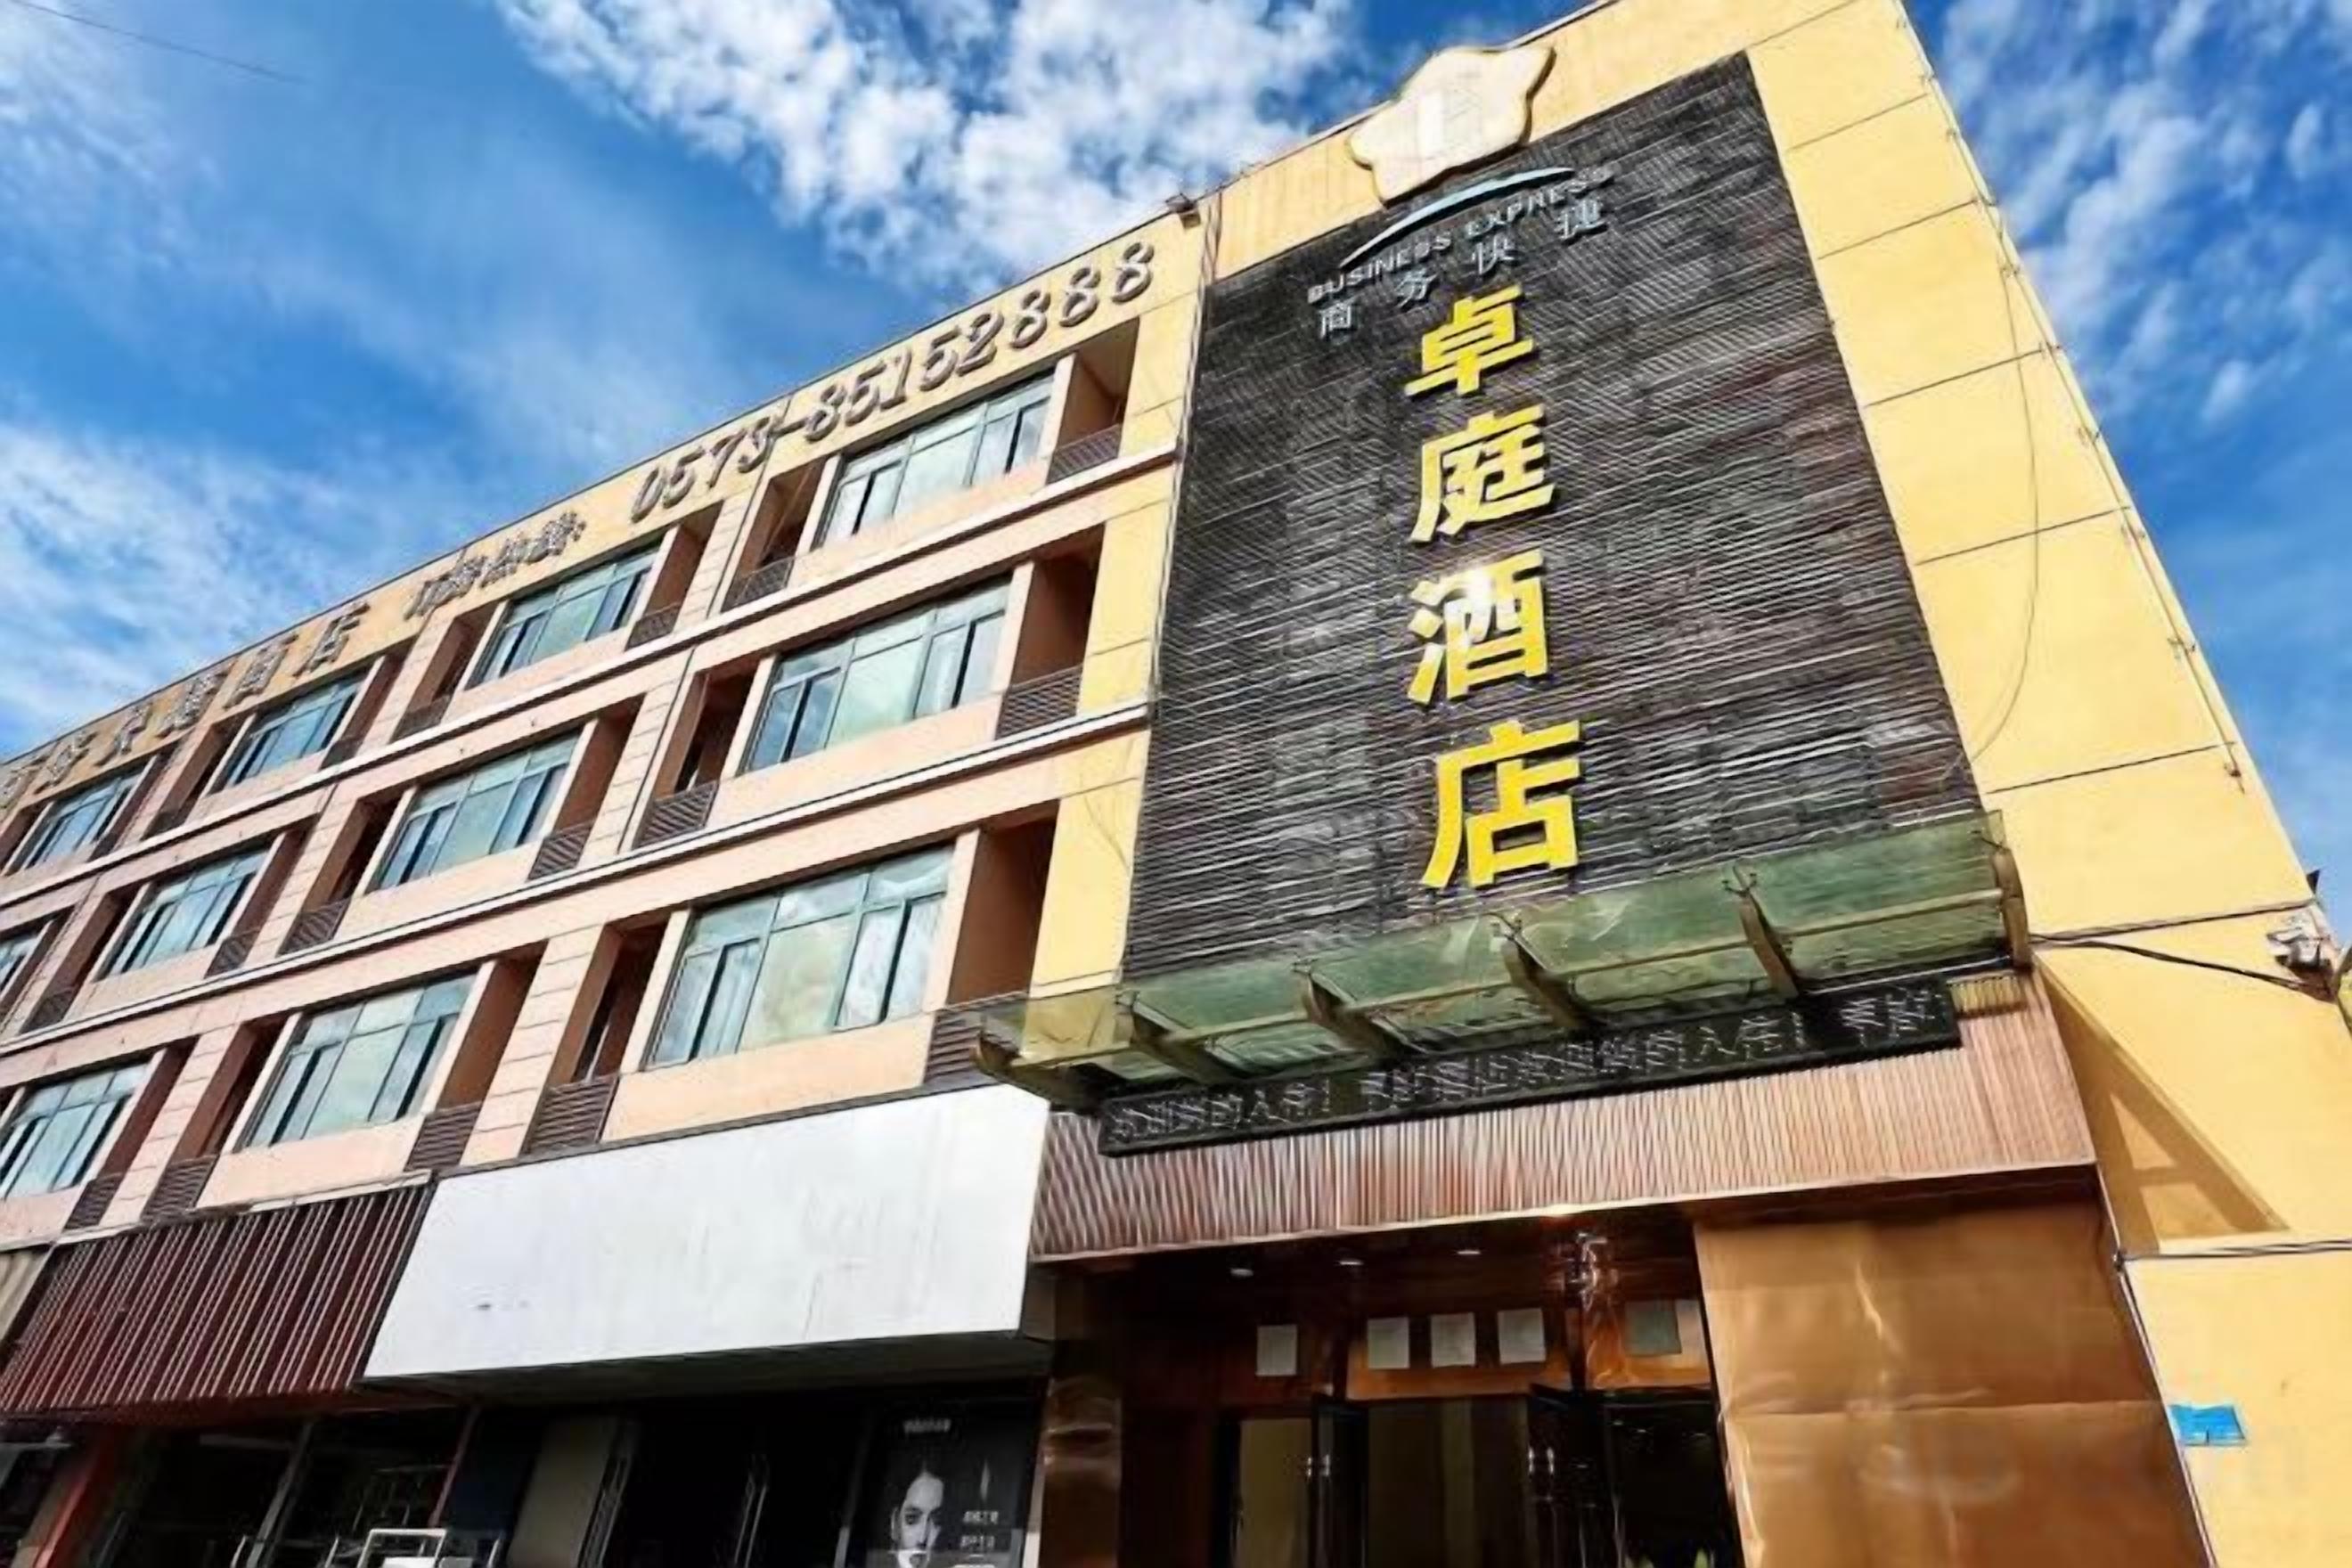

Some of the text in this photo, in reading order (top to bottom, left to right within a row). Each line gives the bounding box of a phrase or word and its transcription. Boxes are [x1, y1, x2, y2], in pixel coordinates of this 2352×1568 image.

[630, 241, 1156, 524] 0573-85152888
[1404, 283, 1582, 890] 卓庭酒店
